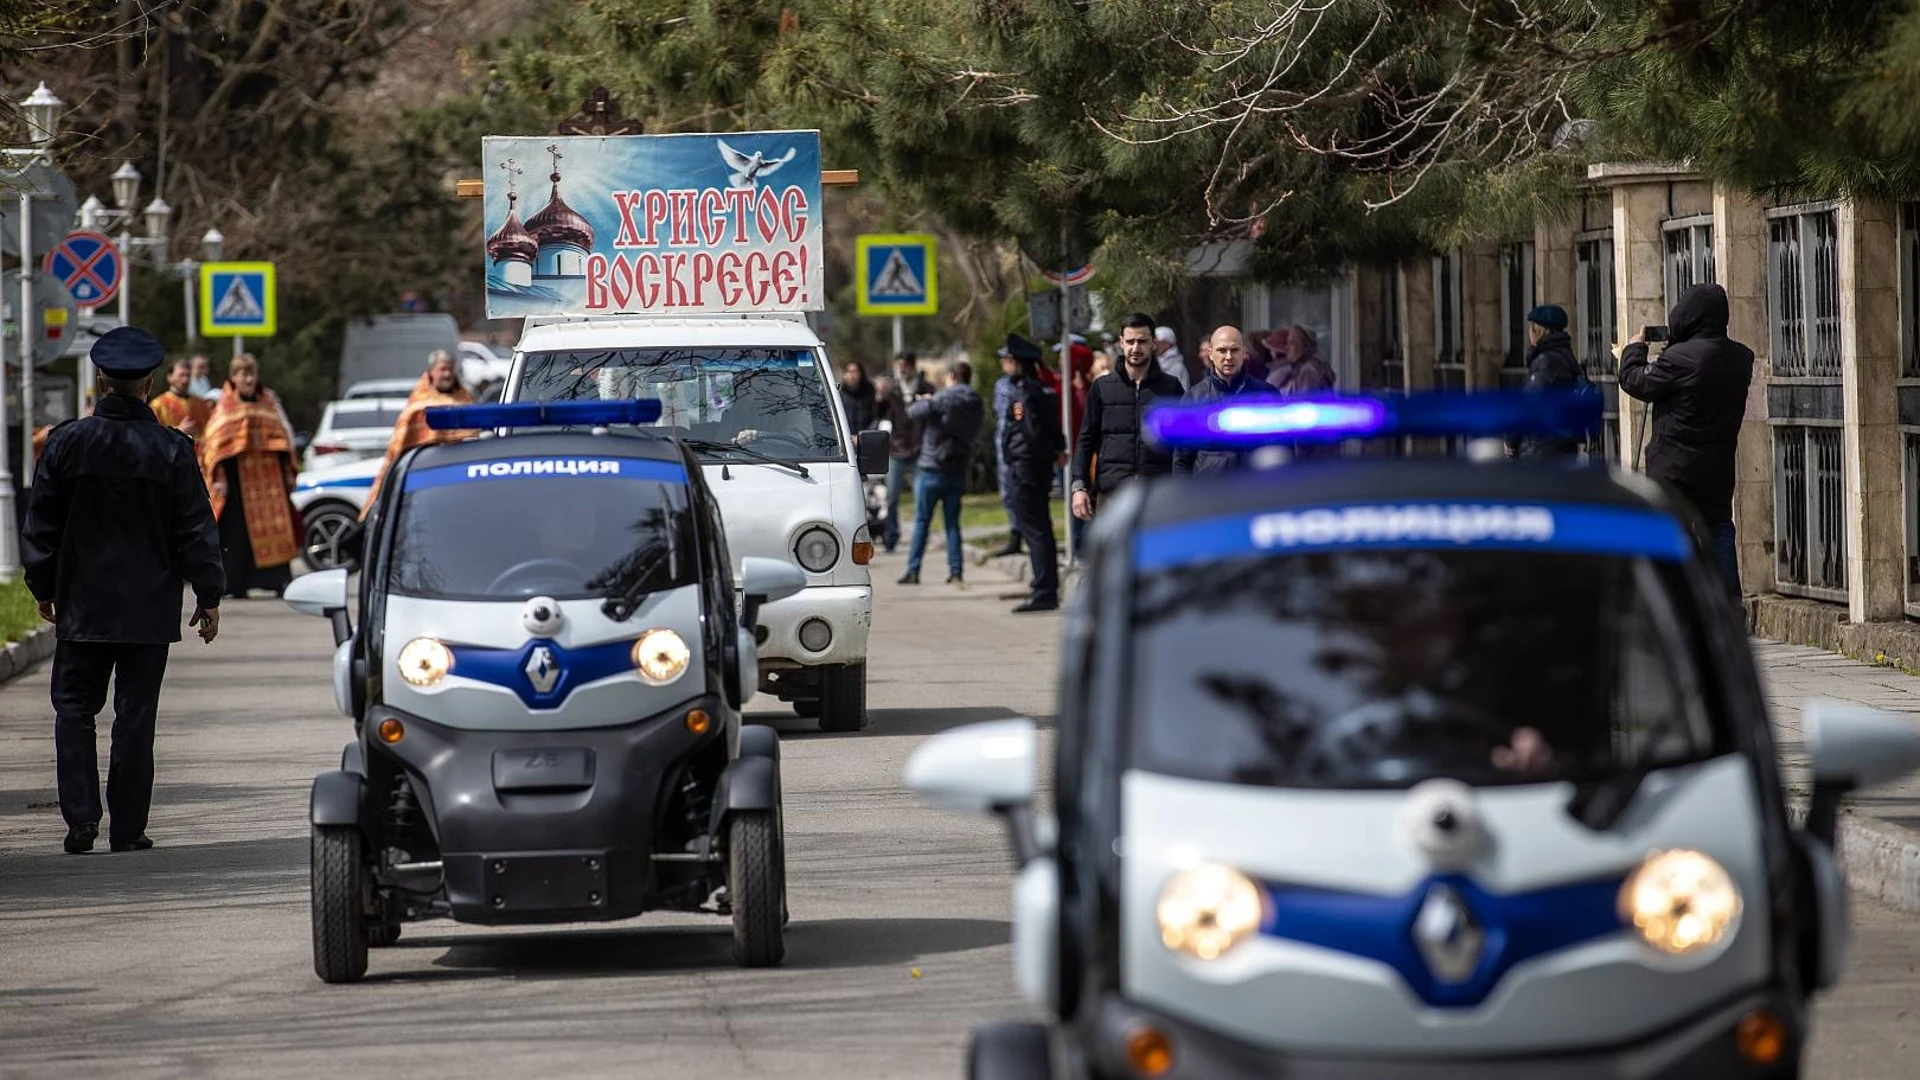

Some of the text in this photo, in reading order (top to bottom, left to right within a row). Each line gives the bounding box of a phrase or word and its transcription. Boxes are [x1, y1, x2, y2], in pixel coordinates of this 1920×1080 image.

[613, 186, 808, 247] ХРИСТОС
[584, 243, 808, 310] ВОСКРЕСЕ!
[467, 460, 620, 478] ПОЛИЦИЯ
